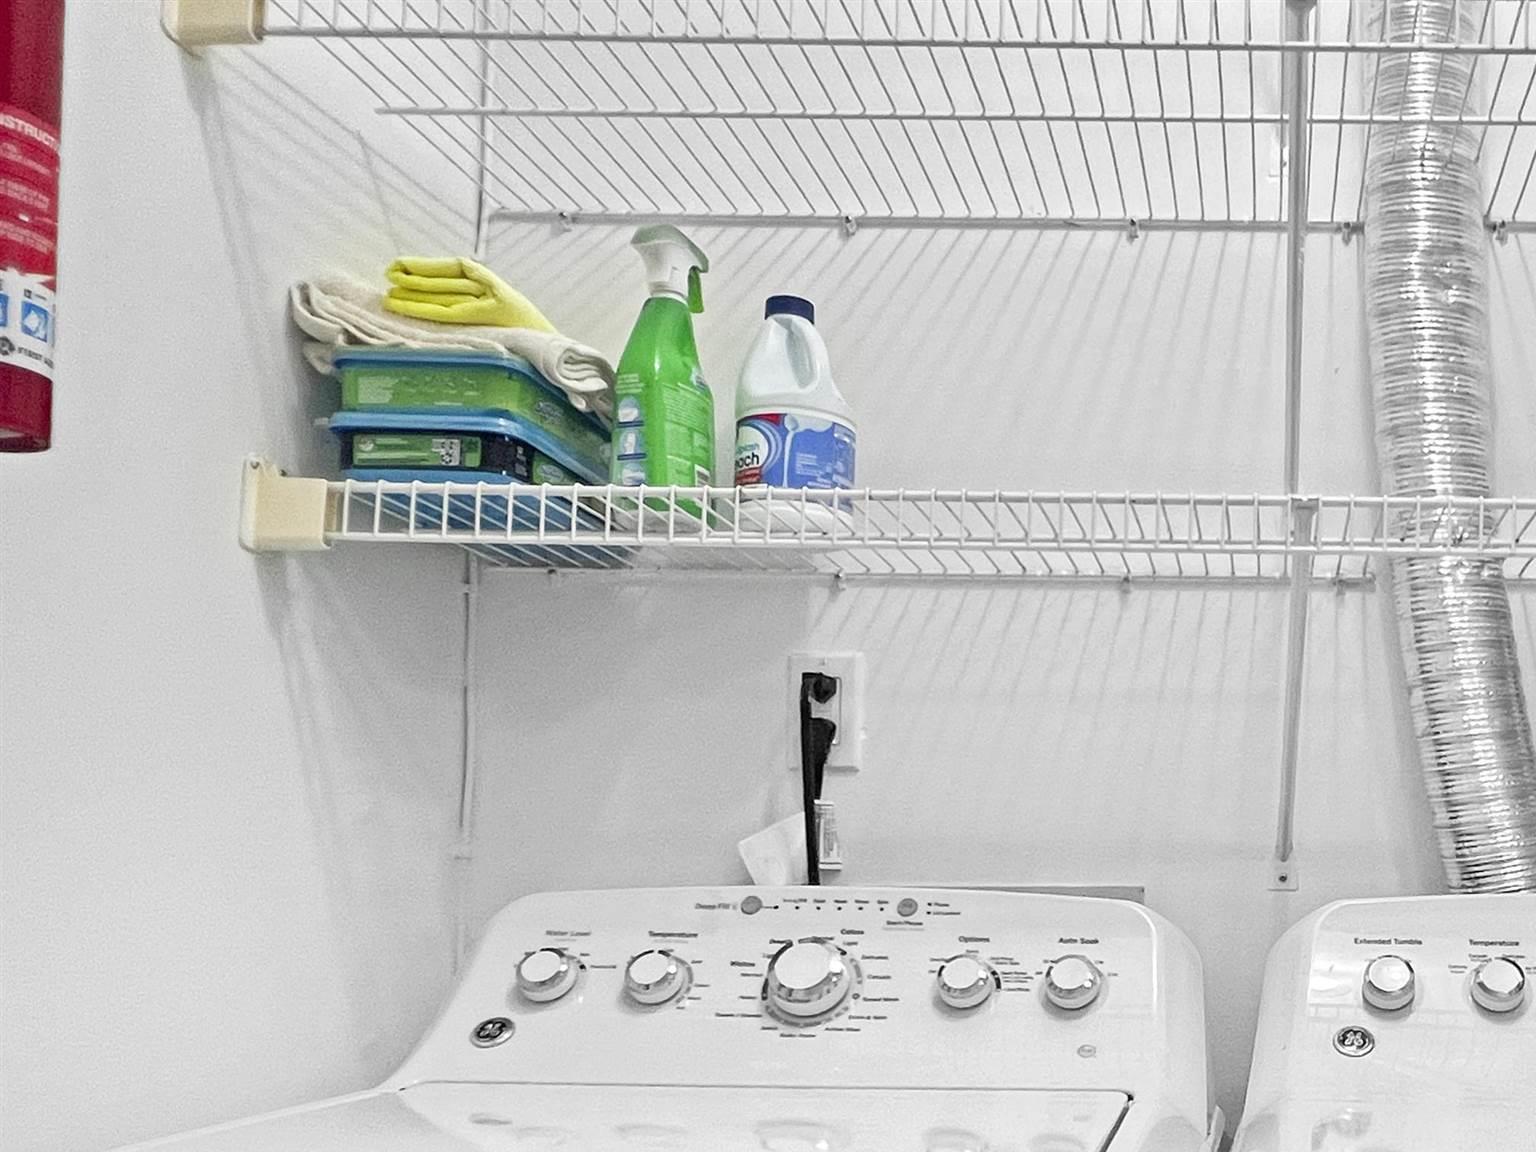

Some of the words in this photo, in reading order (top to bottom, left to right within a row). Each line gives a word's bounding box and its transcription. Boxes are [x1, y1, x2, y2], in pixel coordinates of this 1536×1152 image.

[1354, 937, 1391, 946] Extended
[1393, 938, 1423, 946] Tumble
[1468, 939, 1520, 948] Temperature
